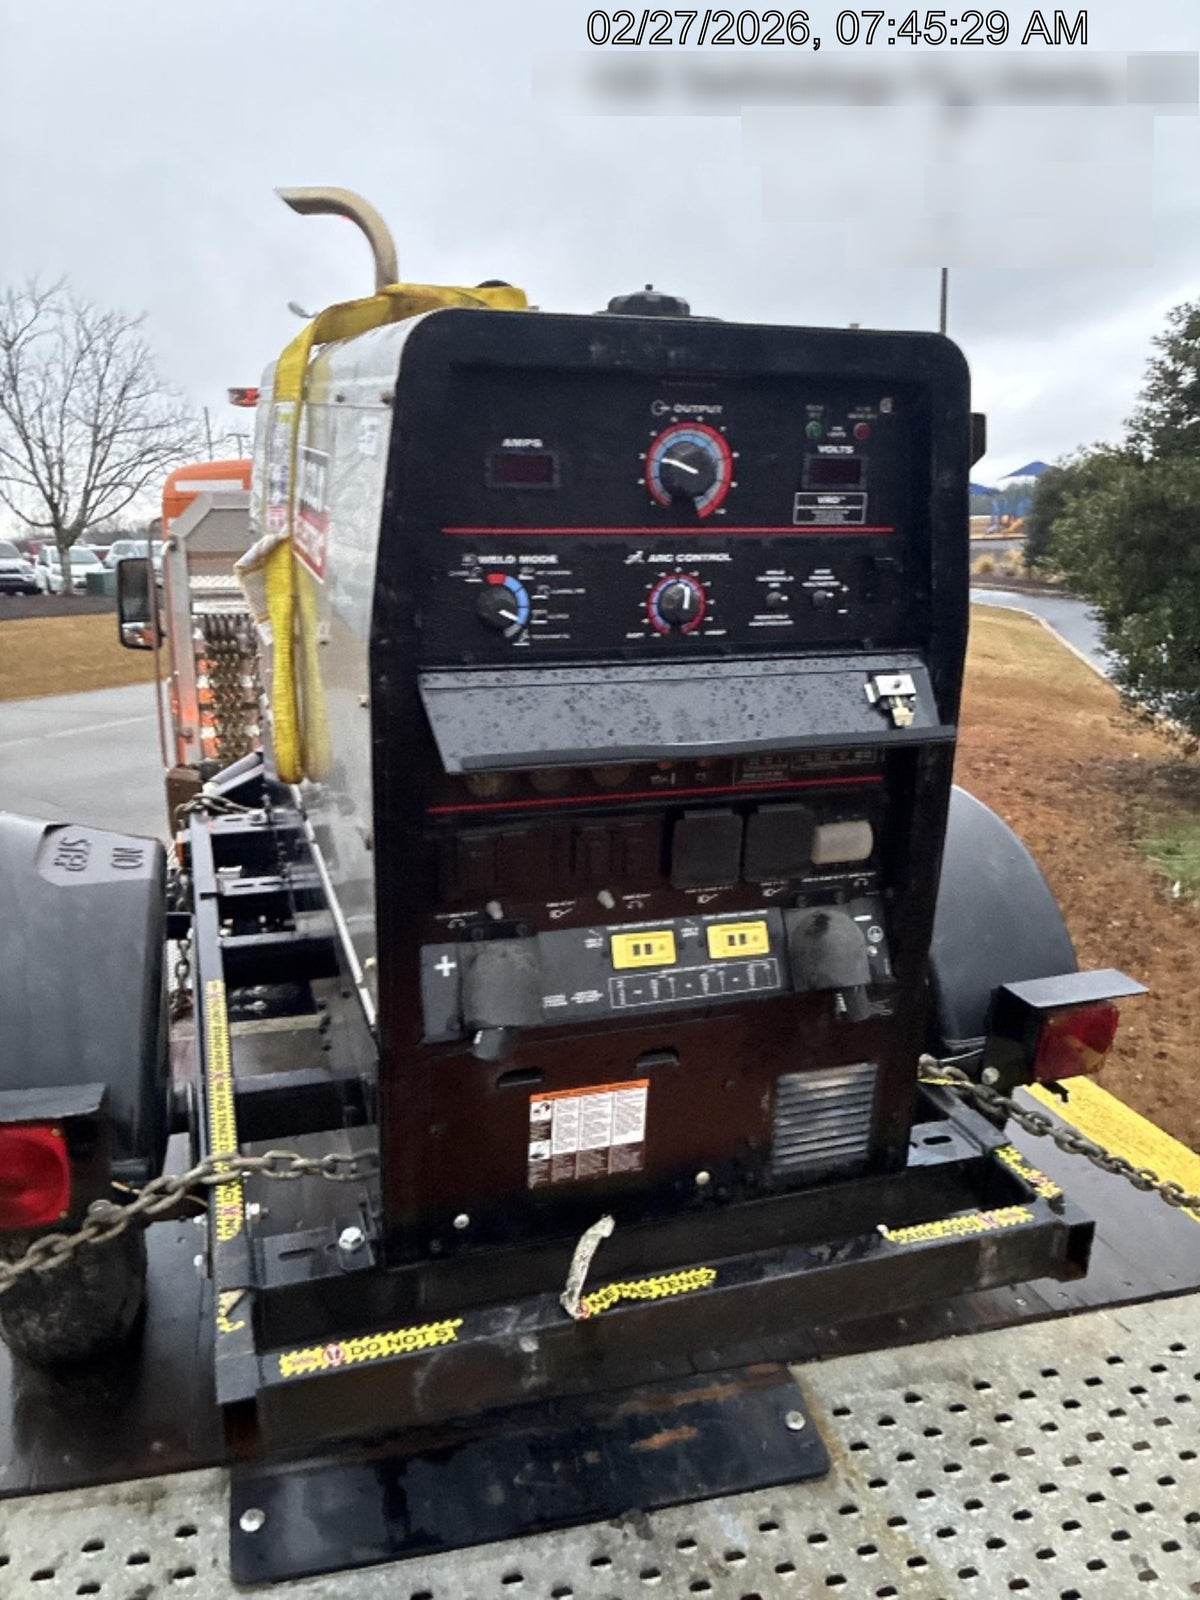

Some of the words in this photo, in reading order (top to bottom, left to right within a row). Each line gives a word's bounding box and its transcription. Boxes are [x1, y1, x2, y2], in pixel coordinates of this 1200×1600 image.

[673, 405, 723, 414] OUTPUT
[501, 438, 544, 448] AMPS
[817, 445, 854, 454] VOLTS
[675, 552, 732, 562] CONTROL
[350, 1340, 381, 1356] DO
[387, 1331, 428, 1349] NOT
